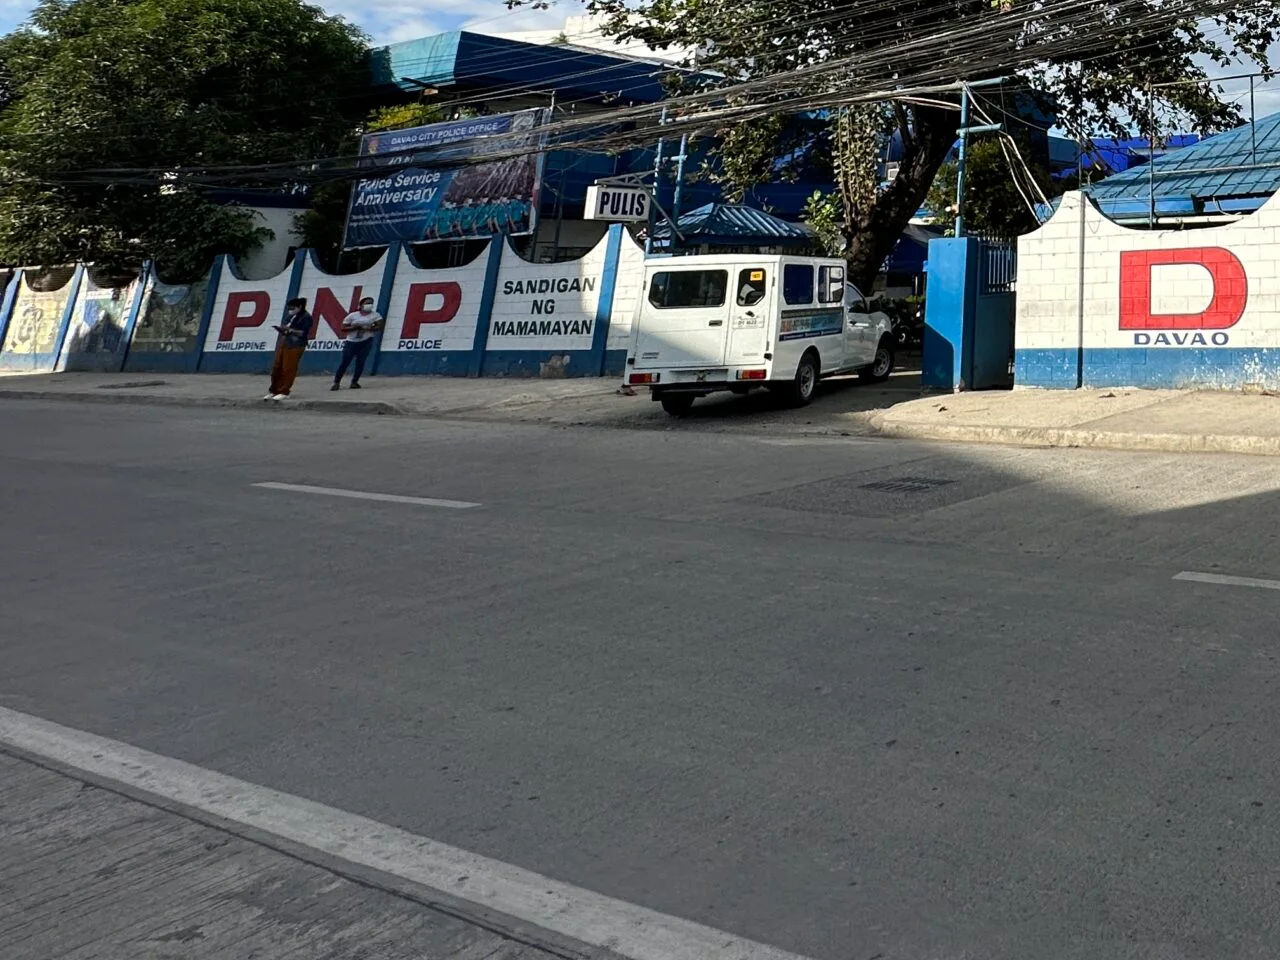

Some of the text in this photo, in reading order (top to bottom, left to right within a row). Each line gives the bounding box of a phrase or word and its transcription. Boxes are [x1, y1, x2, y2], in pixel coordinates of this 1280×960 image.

[391, 134, 417, 145] DAVAO
[418, 131, 436, 141] CITY
[437, 127, 467, 139] POLICE
[468, 122, 498, 134] OFFICE
[358, 171, 441, 191] Police Service
[355, 187, 438, 207] Anniversary
[600, 191, 646, 217] PULIS
[503, 277, 596, 295] SANDIGAN
[531, 299, 555, 315] NG
[492, 319, 593, 336] MAMAMAYAN
[215, 341, 267, 351] PHILIPPINE
[398, 339, 442, 350] POLICE
[1133, 331, 1230, 346] DAVAO
